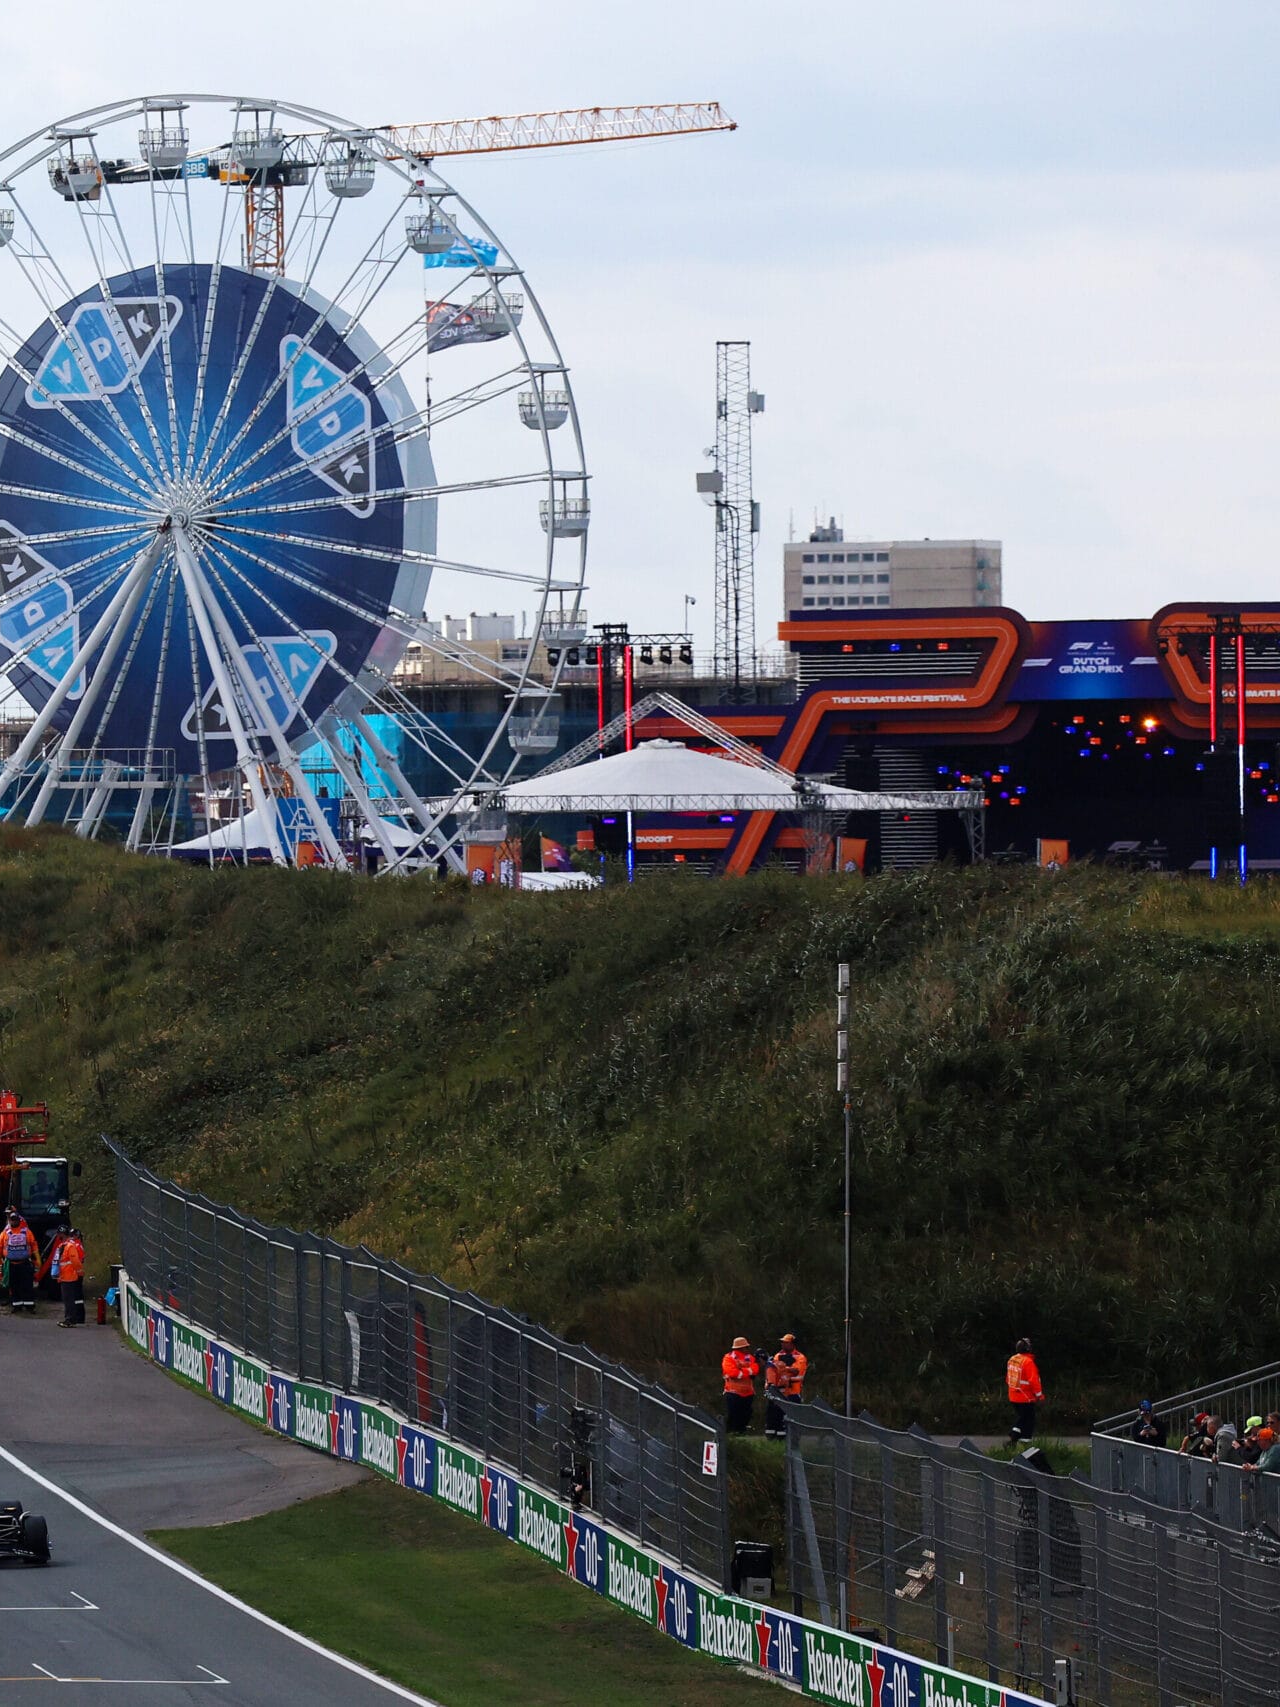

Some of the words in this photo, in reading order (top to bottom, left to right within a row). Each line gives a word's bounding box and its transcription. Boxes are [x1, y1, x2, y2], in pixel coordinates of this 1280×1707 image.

[1059, 665, 1097, 674] GRAND
[1098, 665, 1124, 673] PRIX
[1073, 657, 1109, 665] DUTCH
[832, 696, 850, 704] THE
[851, 696, 896, 704] ULTIMATE
[897, 695, 921, 703] RACE
[923, 694, 967, 702] FESTIVAL
[295, 1391, 328, 1448] Heineken
[361, 1412, 395, 1474] Heineken
[437, 1446, 478, 1514] Heineken
[518, 1489, 562, 1563] Heineken
[608, 1542, 652, 1618] Heineken
[698, 1593, 753, 1663] Heineken
[804, 1631, 864, 1707] Heineken
